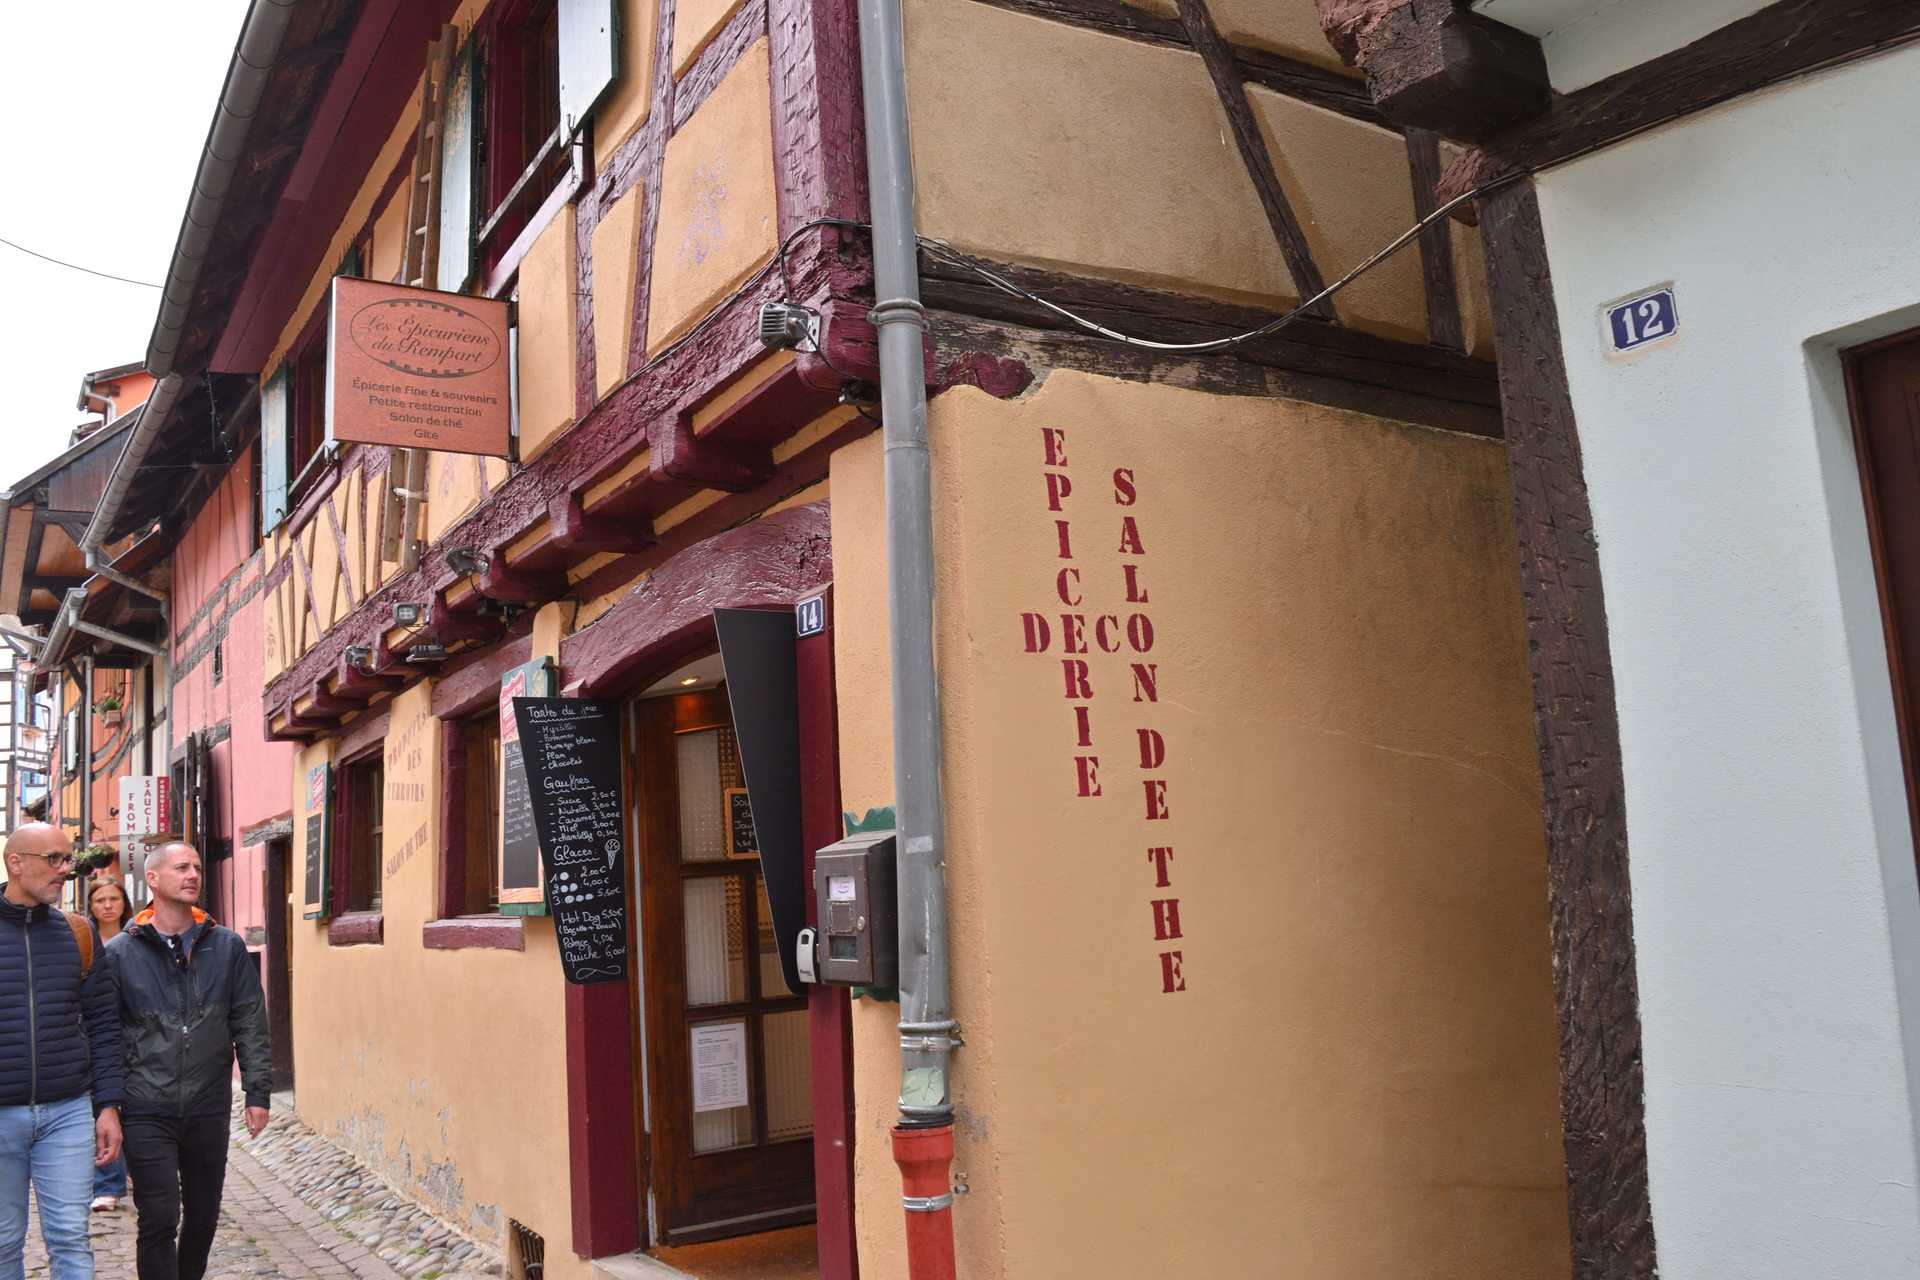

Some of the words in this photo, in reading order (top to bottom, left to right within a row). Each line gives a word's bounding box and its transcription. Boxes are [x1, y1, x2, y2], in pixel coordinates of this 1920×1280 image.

[360, 314, 391, 332] Les
[398, 314, 490, 345] Épicuriens
[1622, 300, 1664, 344] 12
[372, 336, 392, 350] du
[398, 338, 482, 365] Rempart
[352, 377, 402, 394] Épicerie
[431, 388, 440, 398] &
[442, 389, 498, 405] souvenirs
[369, 395, 406, 409] Petite
[409, 401, 482, 417] restauration
[390, 412, 423, 424] Salon
[426, 414, 441, 426] de
[443, 416, 463, 429] thé
[1113, 468, 1159, 703] SALON
[802, 602, 818, 631] 14
[1042, 428, 1103, 798] EPICERIE
[562, 705, 576, 715] du
[1136, 729, 1170, 820] DE
[1148, 847, 1187, 994] THE
